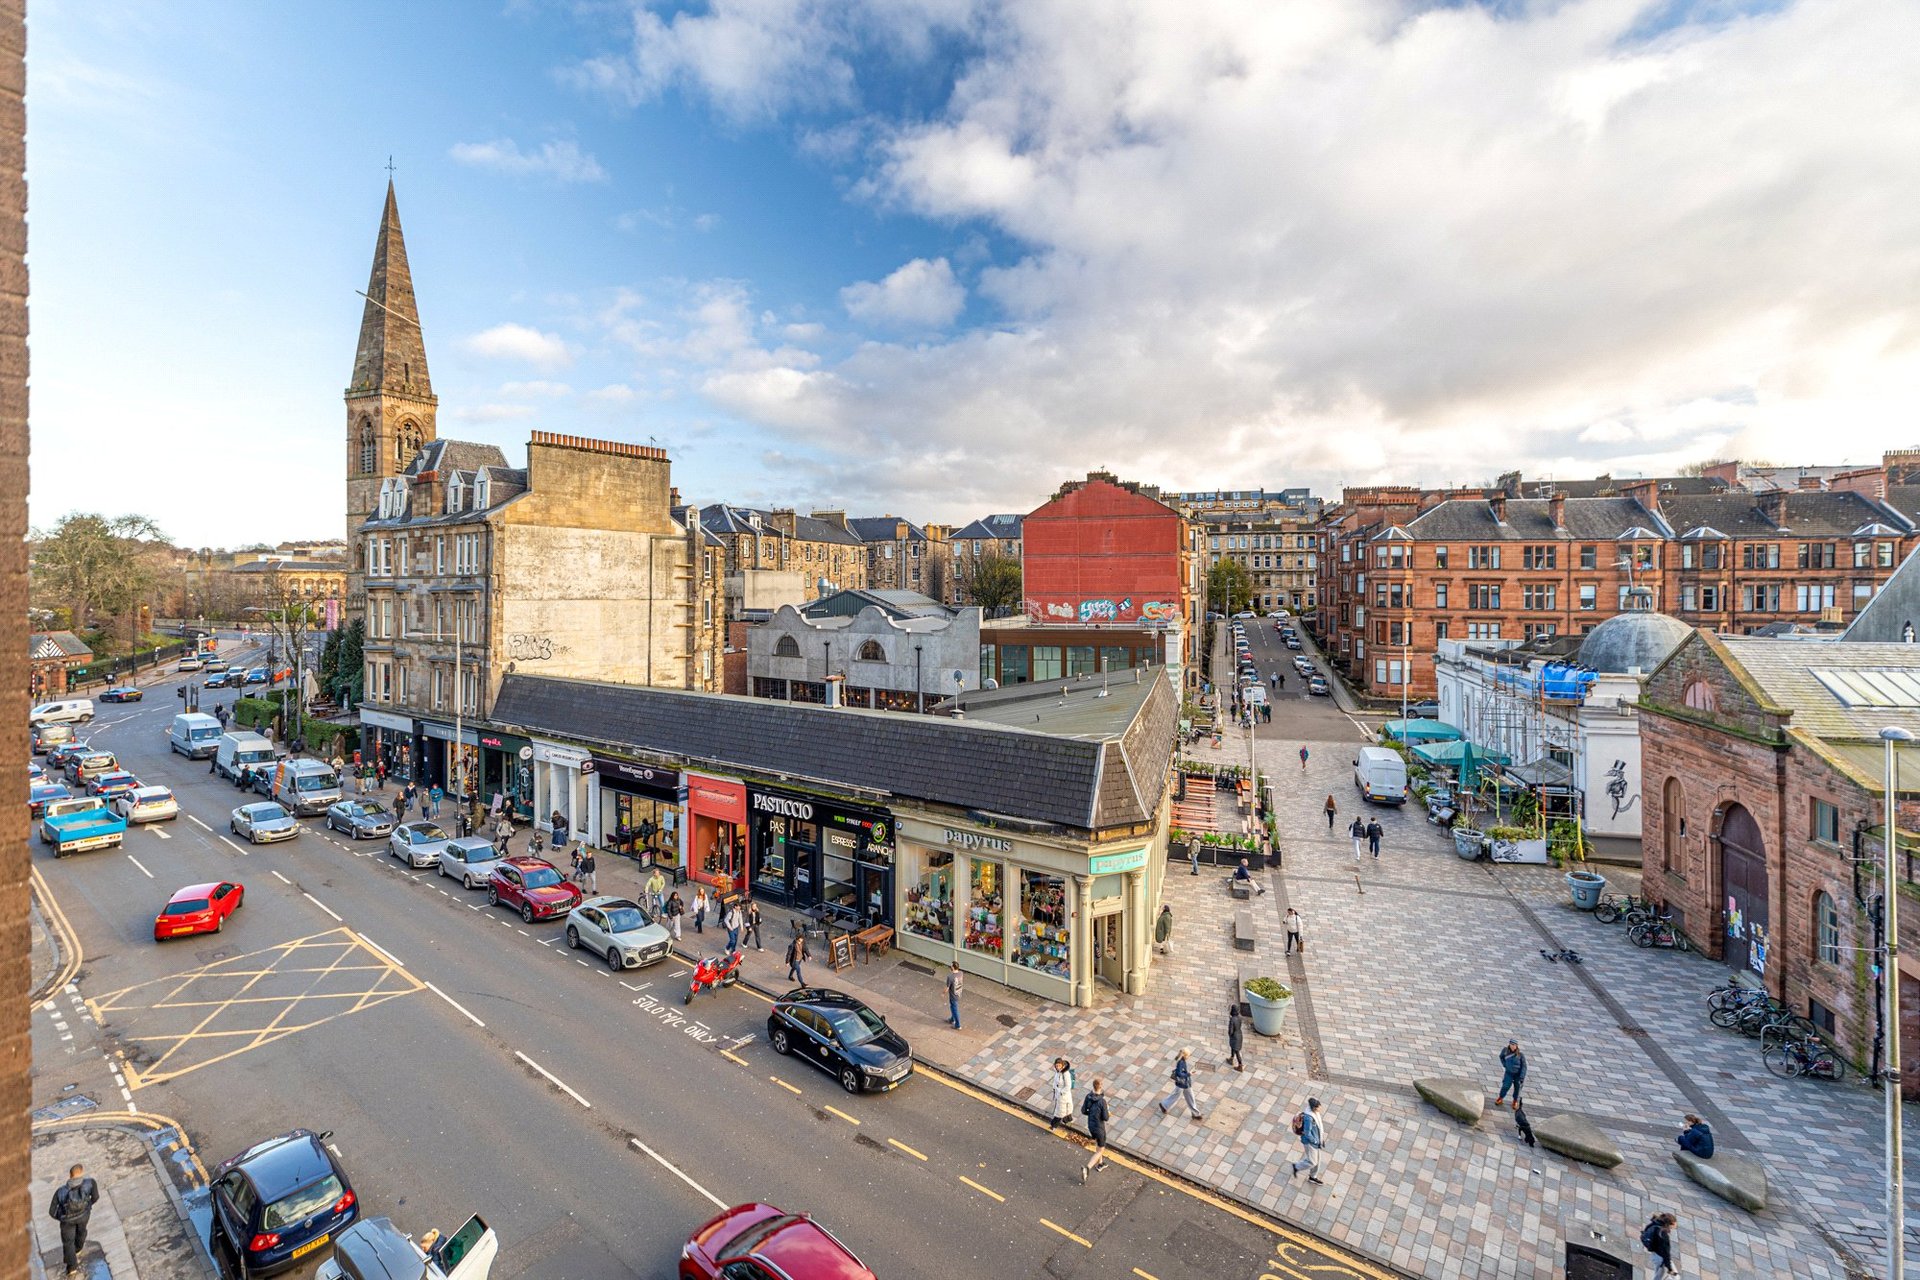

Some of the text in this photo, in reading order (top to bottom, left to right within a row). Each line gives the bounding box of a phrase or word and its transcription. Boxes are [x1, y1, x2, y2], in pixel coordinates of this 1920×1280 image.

[753, 793, 813, 820] PASTICCIO
[943, 828, 1013, 852] papyrus
[1095, 852, 1144, 872] papyrus
[632, 997, 665, 1015] SOLO
[683, 1025, 717, 1043] ONLY
